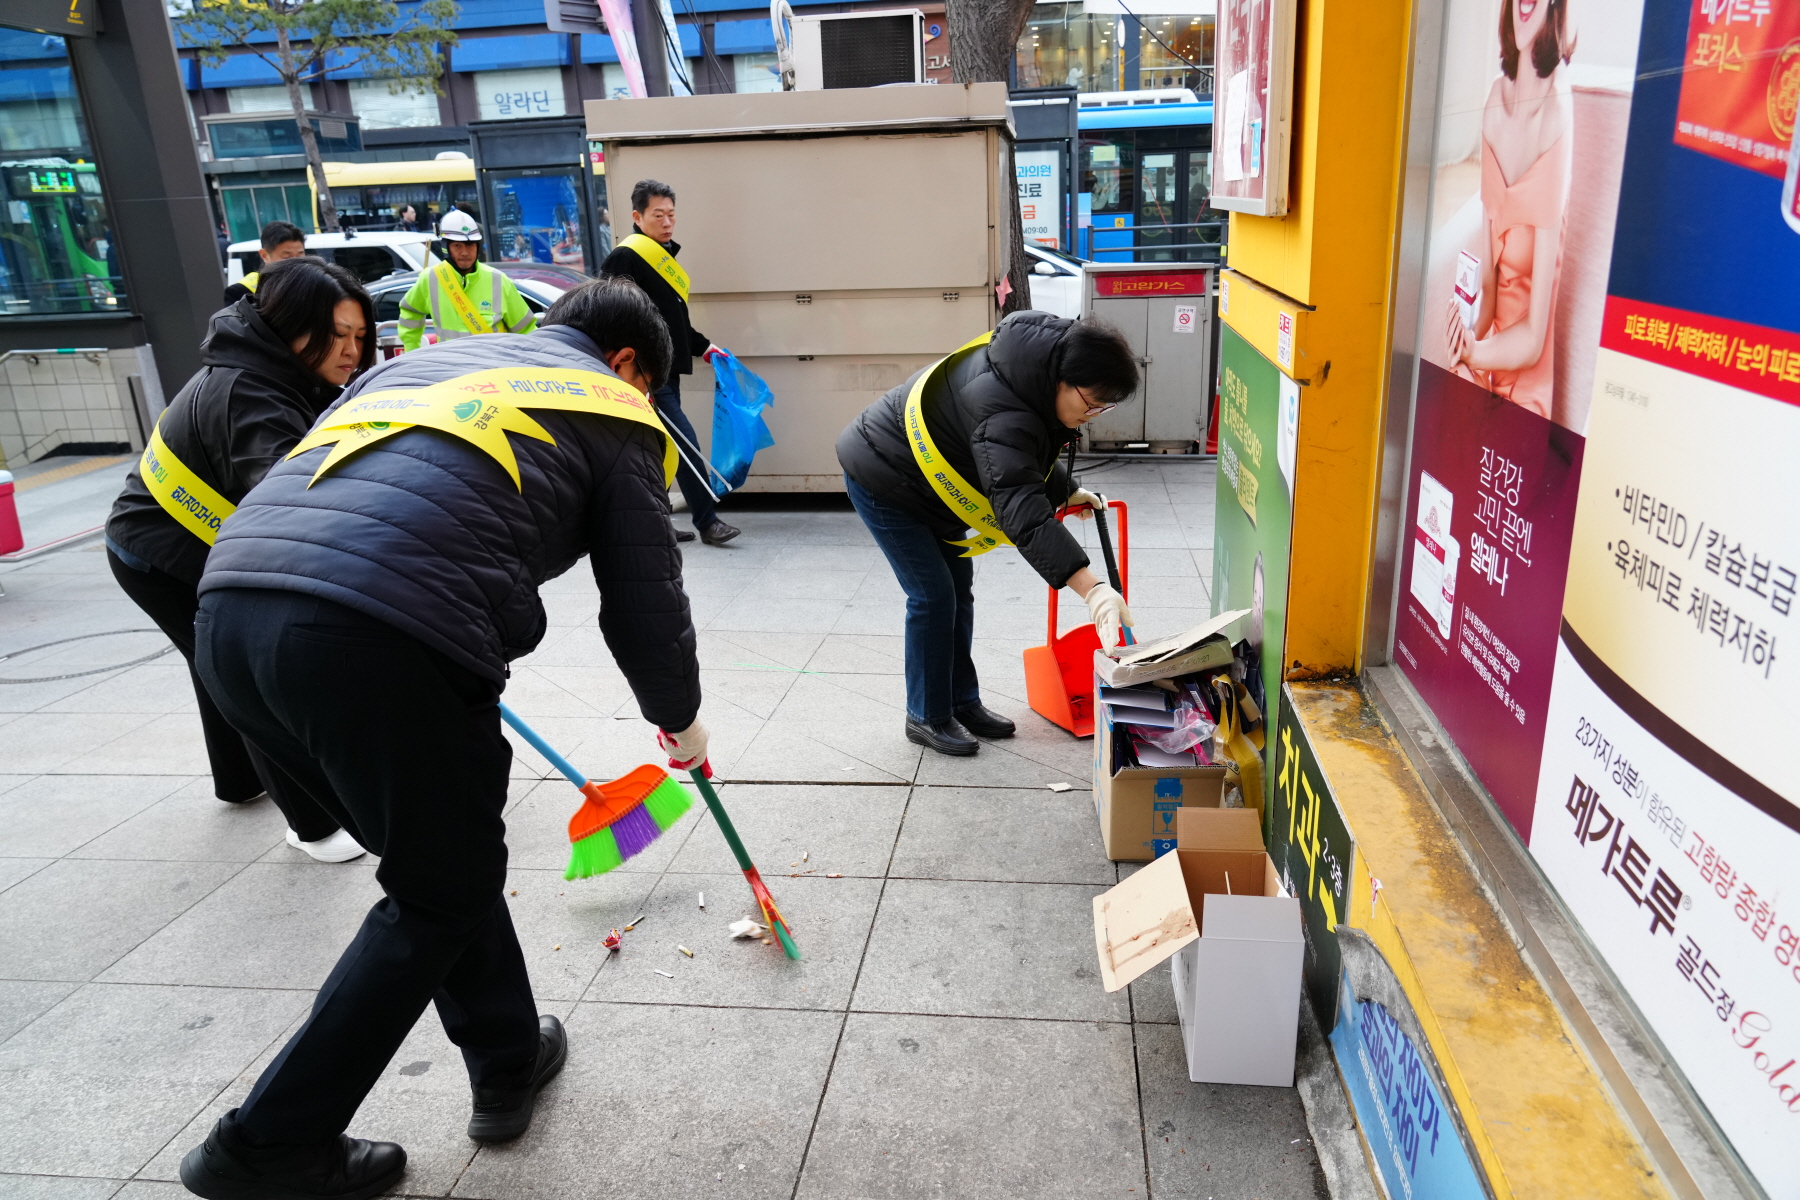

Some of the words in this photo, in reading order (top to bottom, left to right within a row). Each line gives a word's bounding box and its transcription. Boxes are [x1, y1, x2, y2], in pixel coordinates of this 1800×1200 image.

[1693, 32, 1742, 73] 포커스
[494, 89, 550, 115] 알라딘
[1016, 165, 1052, 177] 과의원
[1122, 281, 1185, 291] 고압가스
[507, 379, 587, 398] 내손으로
[473, 405, 500, 431] 강북구
[170, 485, 222, 533] 환경보호
[1473, 490, 1501, 538] 고민
[1502, 507, 1532, 568] 끝엔,
[1470, 532, 1508, 597] 엘레나
[1623, 485, 1687, 549] 비타민D
[1705, 529, 1797, 617] 칼슘보급
[1615, 539, 1682, 613] 육체피로
[1687, 587, 1776, 679] 체력저하
[1509, 699, 1516, 712] 수
[1515, 704, 1526, 725] 있음
[1279, 725, 1321, 902] 치과
[1575, 716, 1614, 772] 23가지
[1612, 754, 1650, 809] 성분이
[1647, 793, 1687, 849] 함유된
[1684, 830, 1737, 899] 고함량
[1734, 883, 1775, 942] 종합
[1774, 925, 1800, 985] 영
[1676, 935, 1735, 1022] 골드정
[1392, 1082, 1420, 1179] 차이
